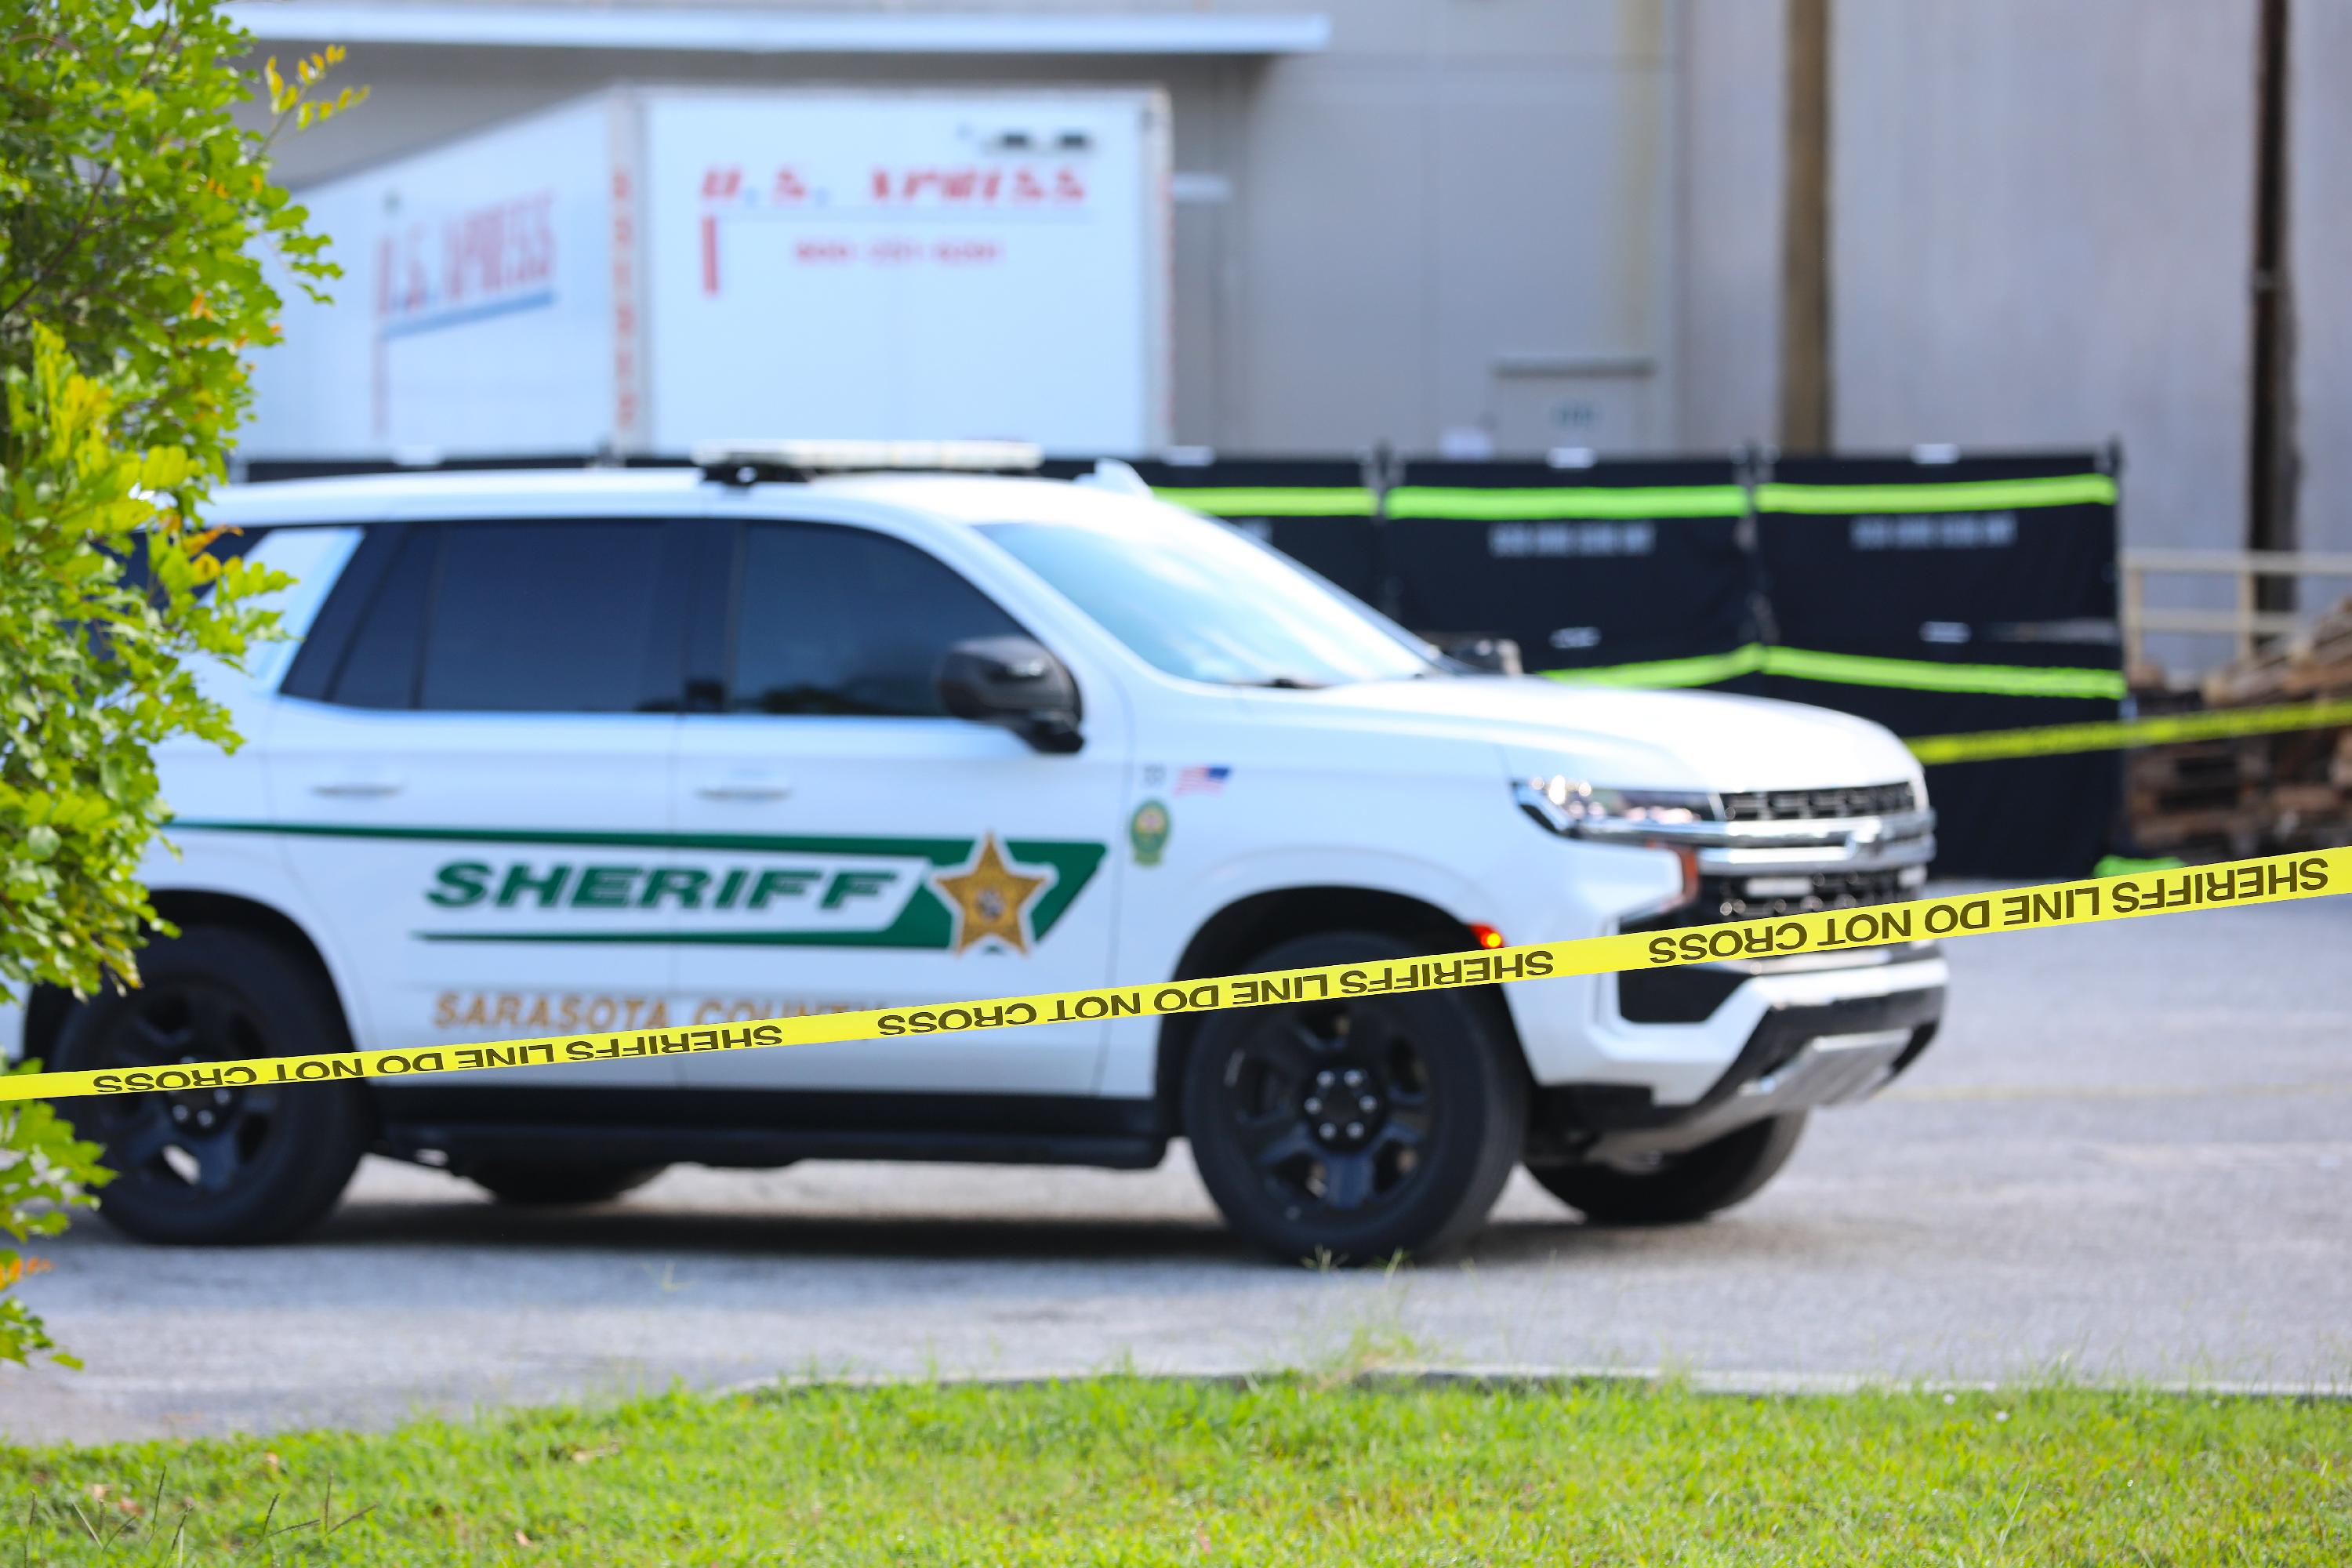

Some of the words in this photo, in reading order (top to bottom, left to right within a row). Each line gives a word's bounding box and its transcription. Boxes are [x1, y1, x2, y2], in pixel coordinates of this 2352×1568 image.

[425, 859, 898, 909] SHERIFF
[2111, 857, 2329, 913] SHERIFFS
[1924, 899, 1990, 934] DO
[2002, 886, 2100, 926] LINE
[1648, 922, 1808, 964] CROSS
[1817, 909, 1911, 946] NOT
[1231, 974, 1328, 1004] LINE
[1339, 950, 1554, 994] SHERIFFS
[434, 989, 670, 1031] SARASOTA
[1047, 992, 1141, 1022] NOT
[1153, 985, 1220, 1011] DO
[877, 1003, 1037, 1036] CROSS
[455, 1043, 554, 1069] LINE
[565, 1025, 782, 1061] SHERIFFS
[93, 1066, 257, 1093] CROSS
[269, 1058, 364, 1082] NOT
[376, 1052, 444, 1074] DO
